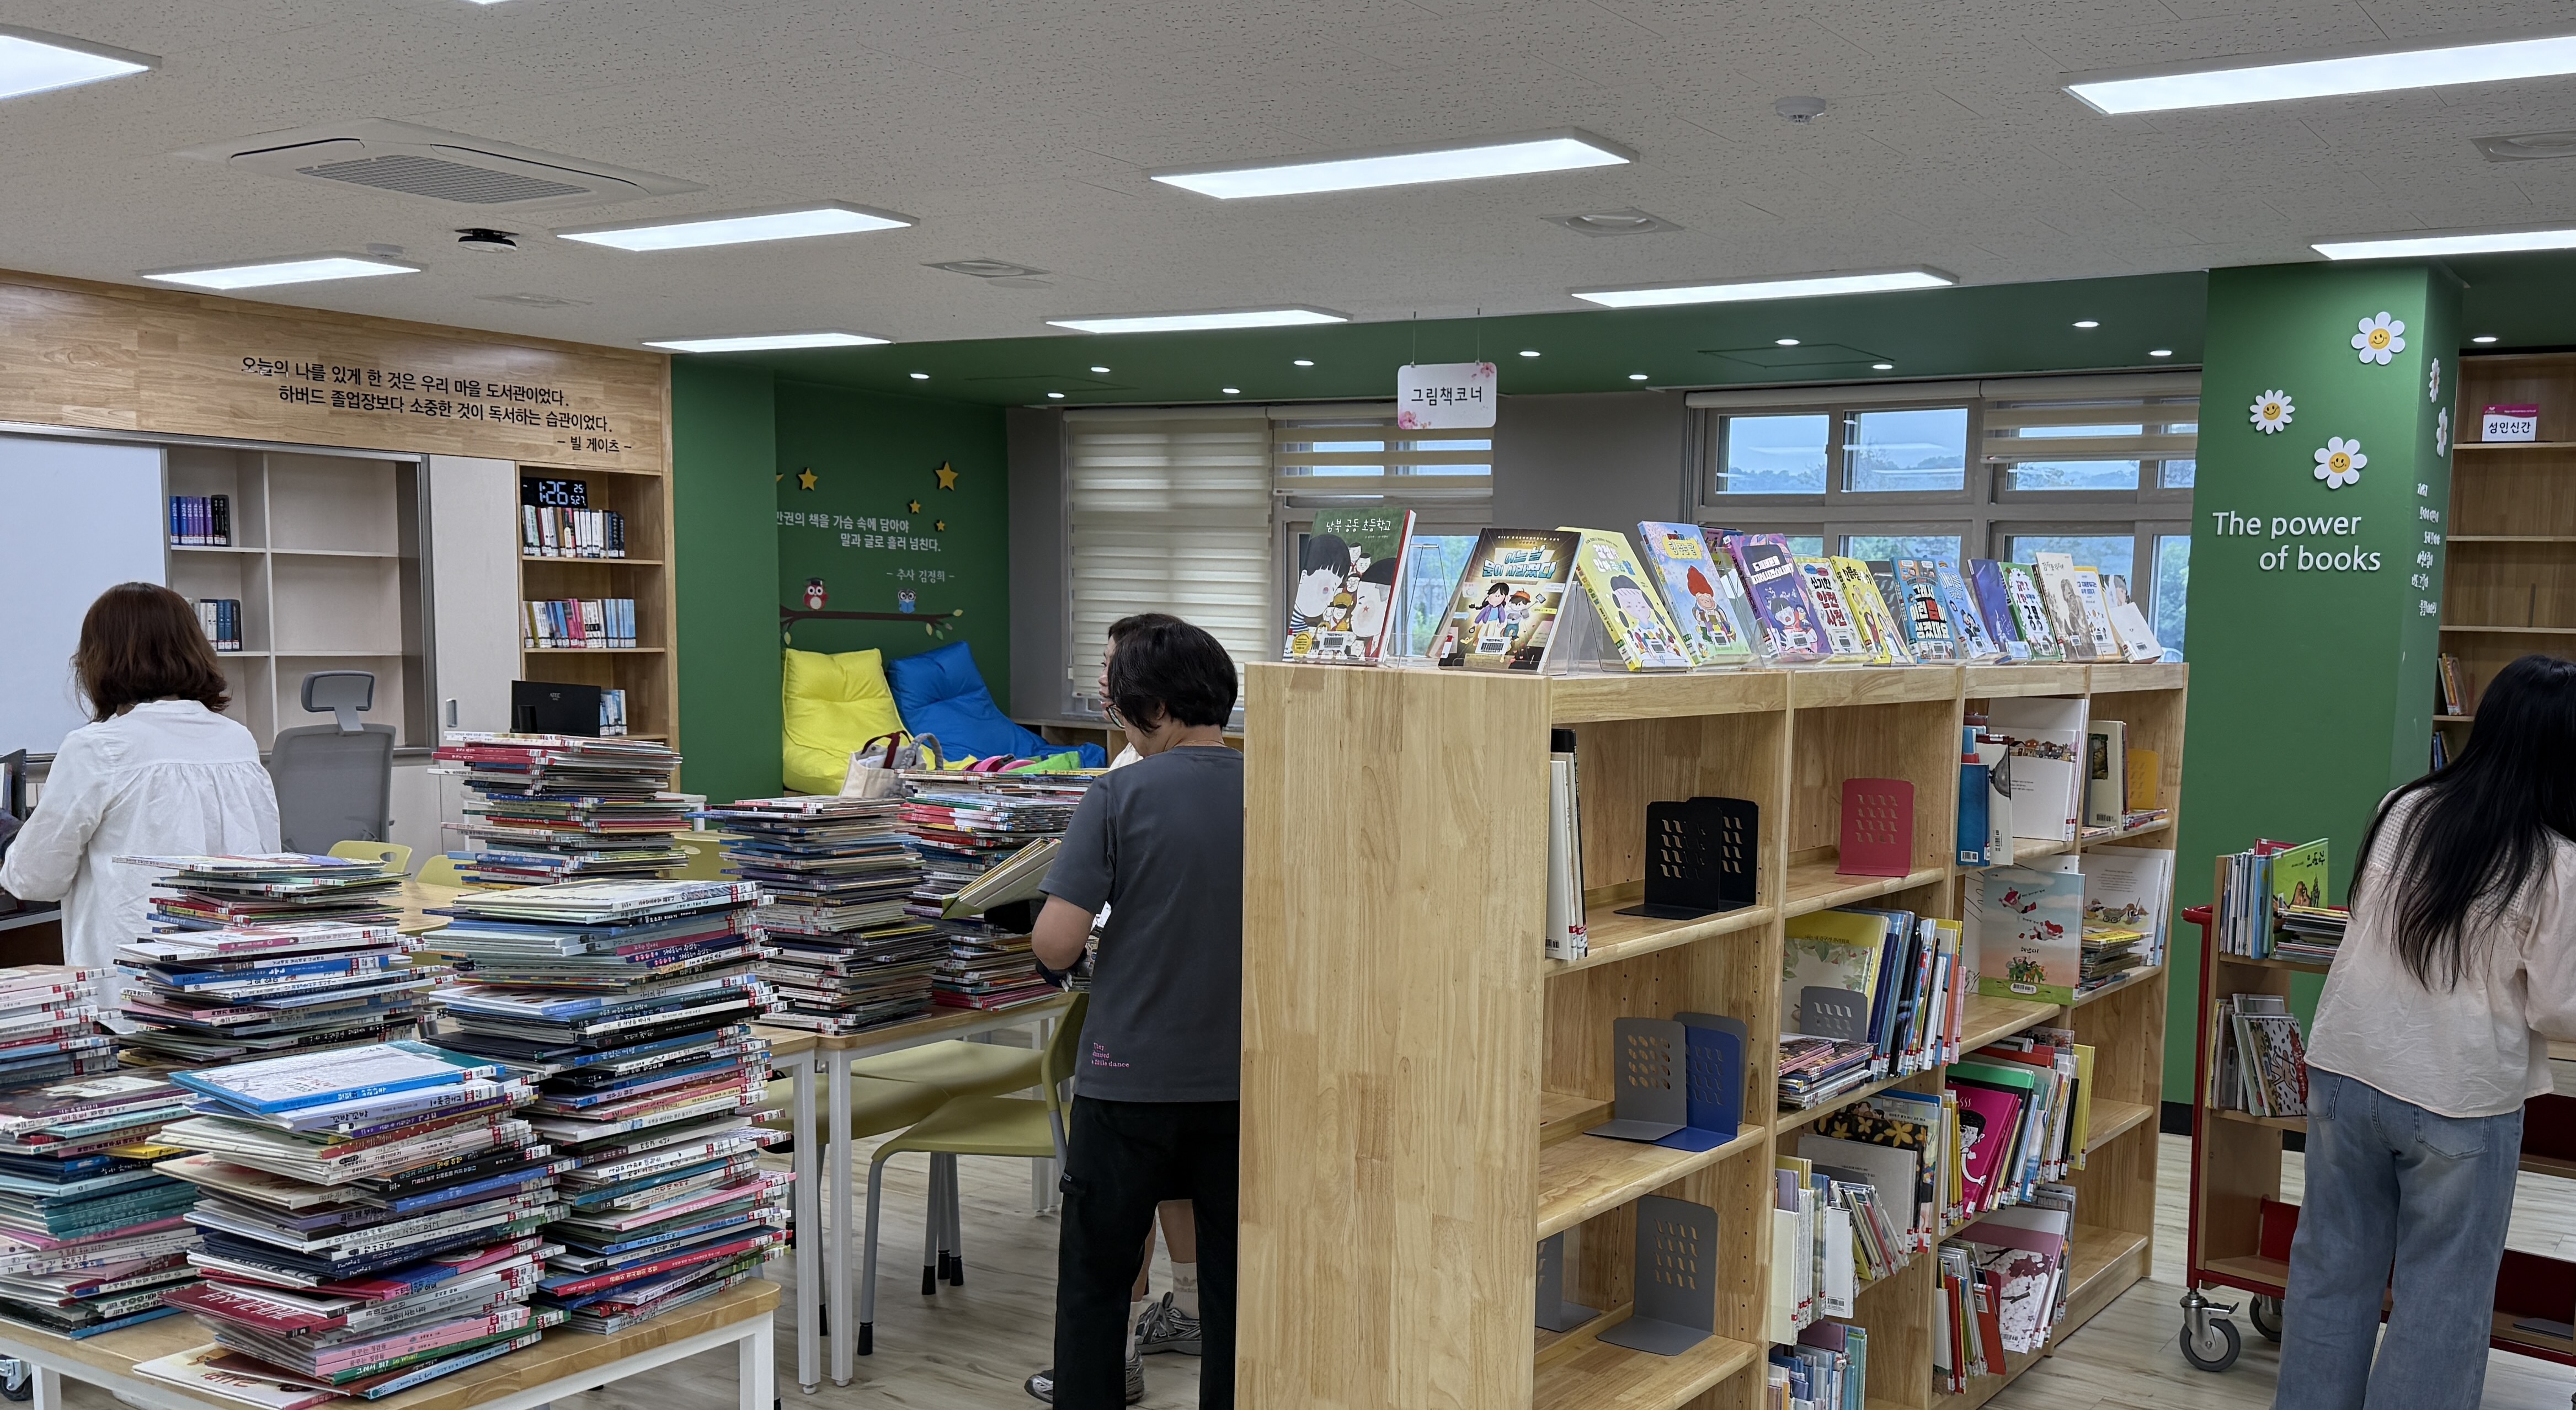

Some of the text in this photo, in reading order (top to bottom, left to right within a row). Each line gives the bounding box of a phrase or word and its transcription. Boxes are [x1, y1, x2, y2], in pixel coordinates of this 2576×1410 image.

[241, 357, 569, 407] 오늘의 나를 있게 한 것은 우리 마을 도서관이었다.
[1411, 386, 1482, 406] 그림책코너
[279, 385, 612, 432] 하버드 졸업장보다 소중한 것이 독서하는 습관이었다.
[2489, 421, 2530, 434] 성인신간
[570, 436, 582, 451] 빌
[586, 437, 620, 453] 게이츠
[539, 480, 568, 505] 1:26
[809, 514, 830, 528] 책을
[833, 515, 854, 530] 가슴
[857, 516, 877, 531] 속에
[880, 519, 909, 533] 담아야
[1326, 517, 1391, 533] 남북 공동 초등학교
[2212, 510, 2362, 540] The power
[841, 533, 941, 552] 말과 글로 흘러 넘친다.
[2259, 544, 2381, 570] of books
[897, 568, 915, 581] 추사
[919, 570, 945, 584] 김정희
